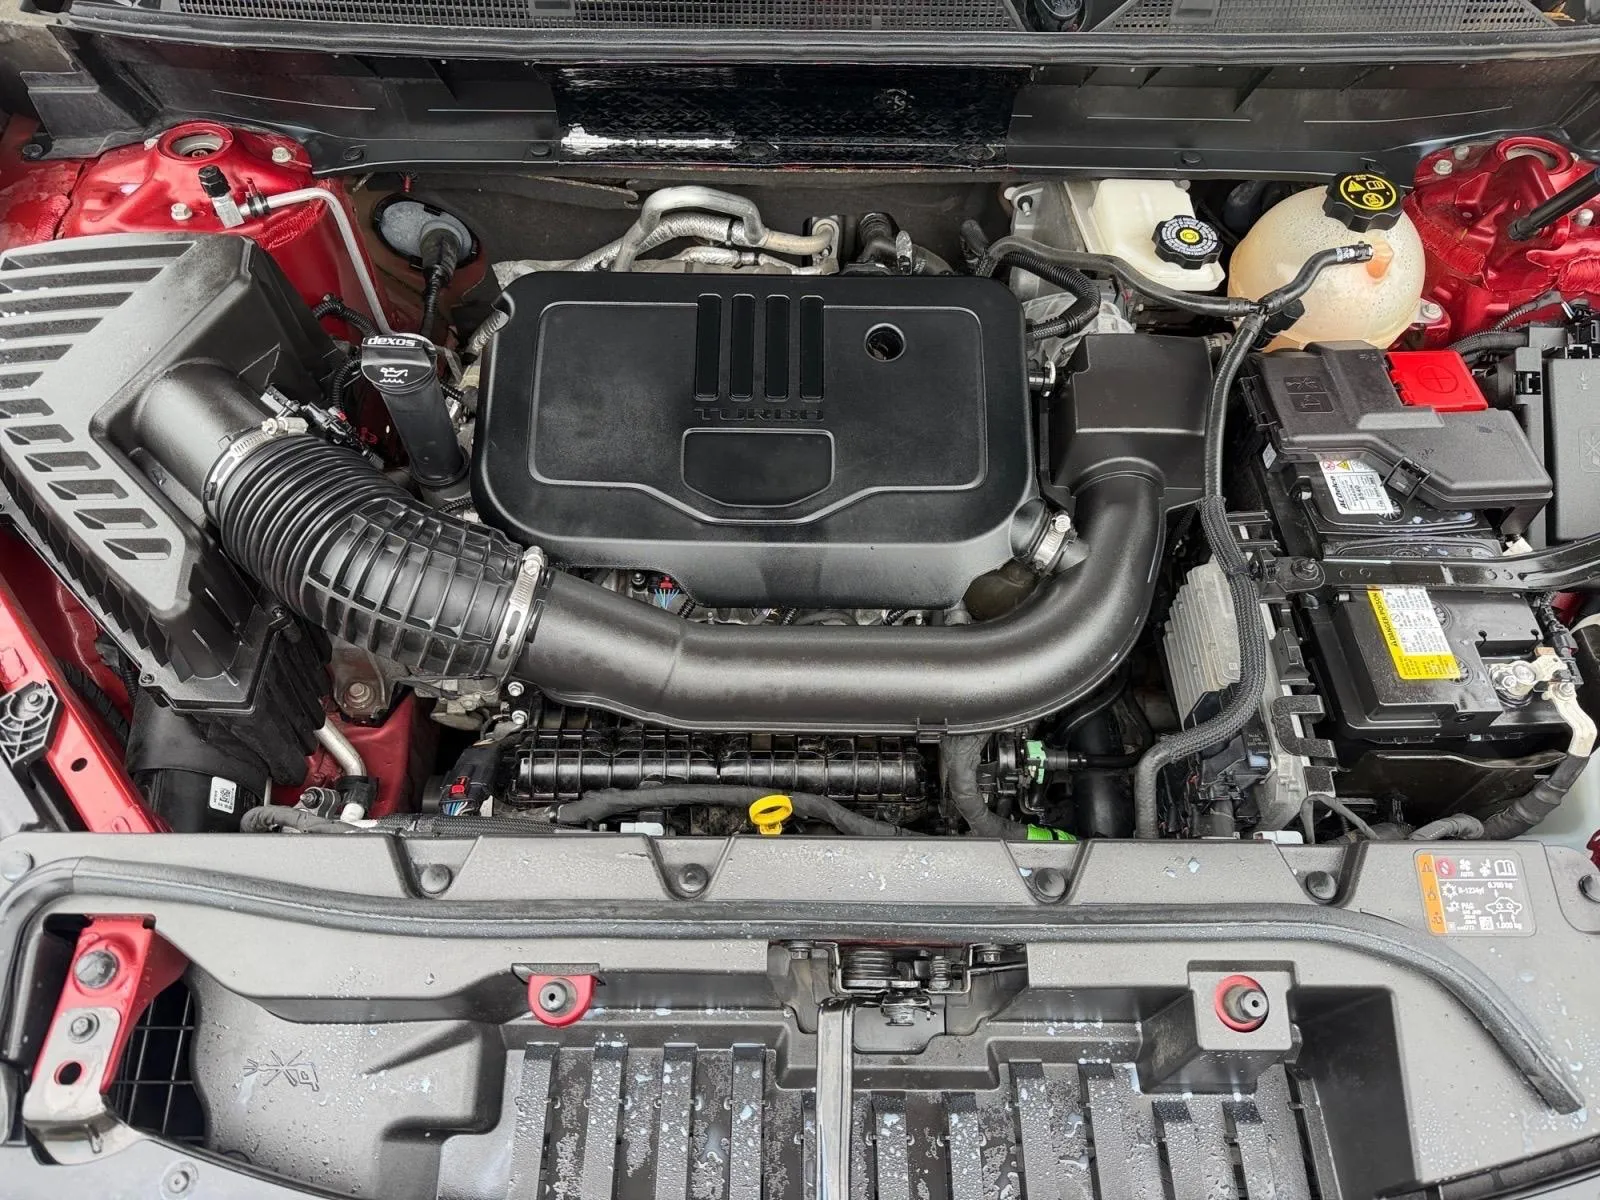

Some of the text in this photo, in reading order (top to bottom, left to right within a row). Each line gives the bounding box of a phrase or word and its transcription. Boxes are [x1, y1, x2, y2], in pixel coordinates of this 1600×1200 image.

[367, 335, 417, 347] dexos
[693, 408, 824, 421] TURBO
[1330, 475, 1348, 509] ACDelco
